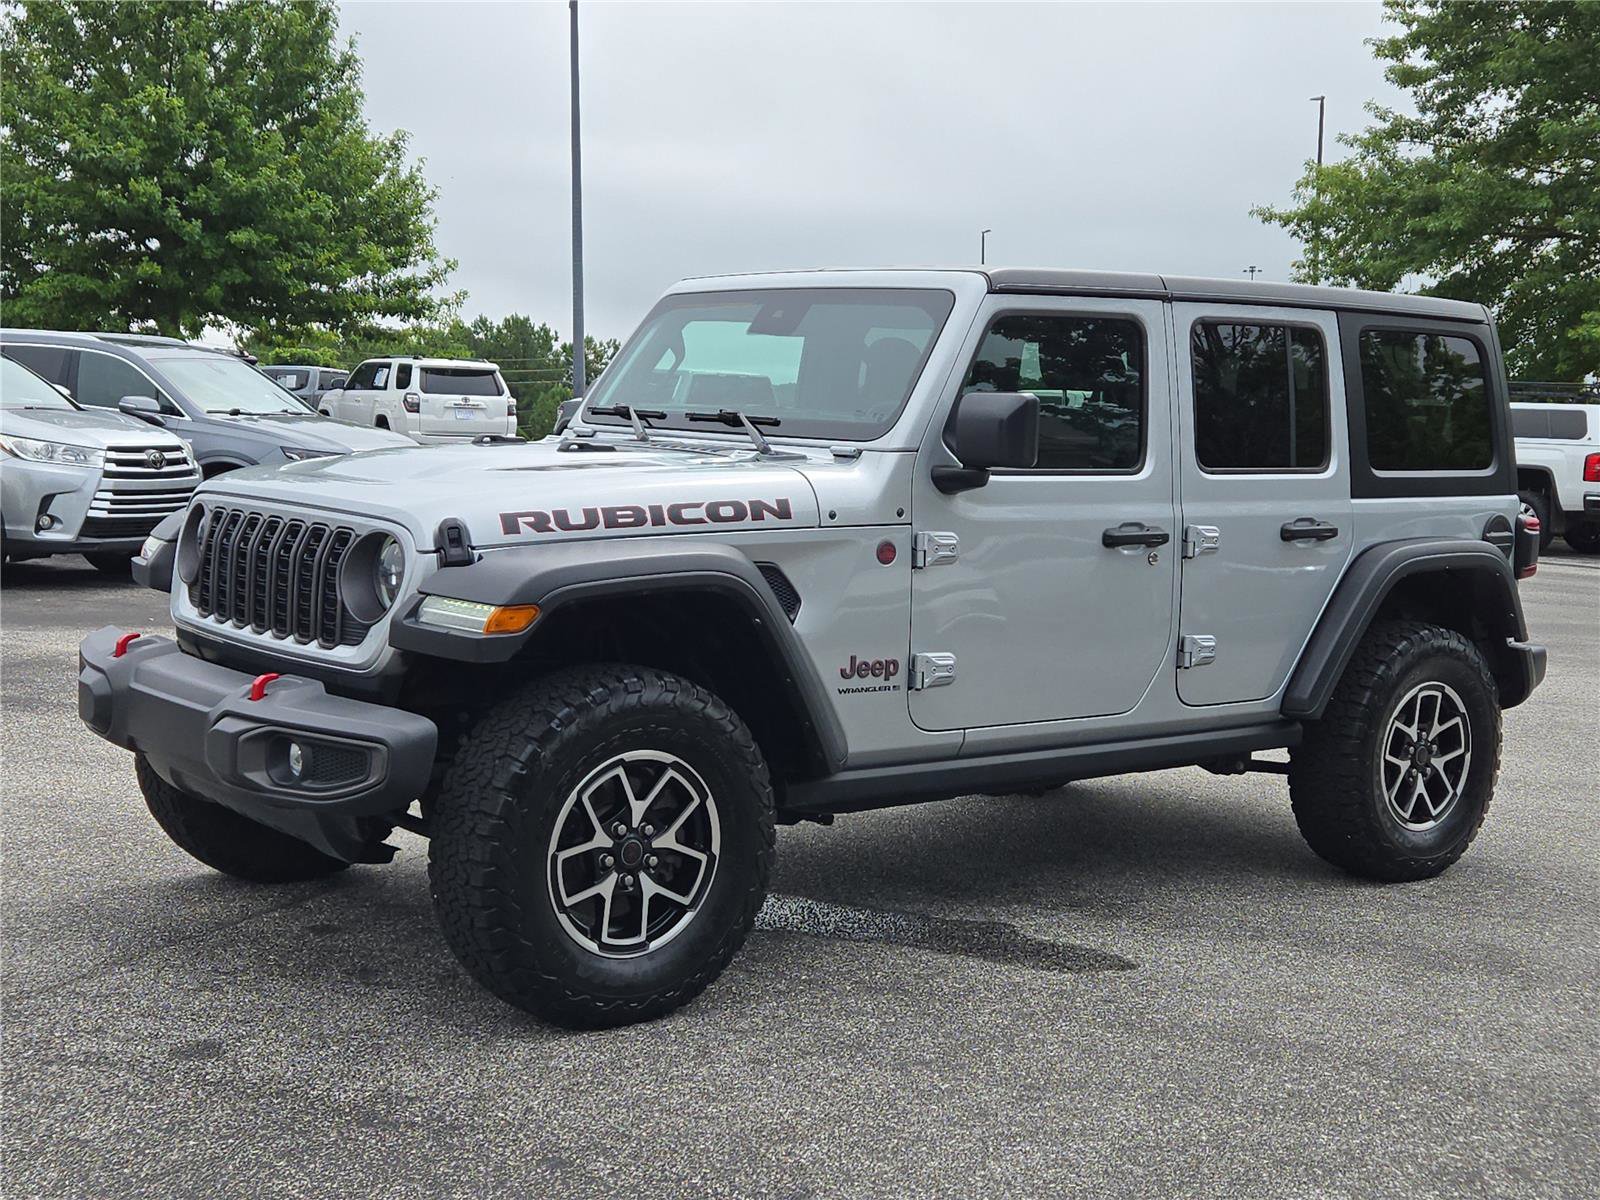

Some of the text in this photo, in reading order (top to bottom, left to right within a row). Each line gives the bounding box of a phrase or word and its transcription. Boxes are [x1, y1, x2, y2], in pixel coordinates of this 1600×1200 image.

[500, 498, 792, 535] RUBICON
[840, 655, 899, 681] Jeep
[837, 685, 891, 695] WRANGLER
